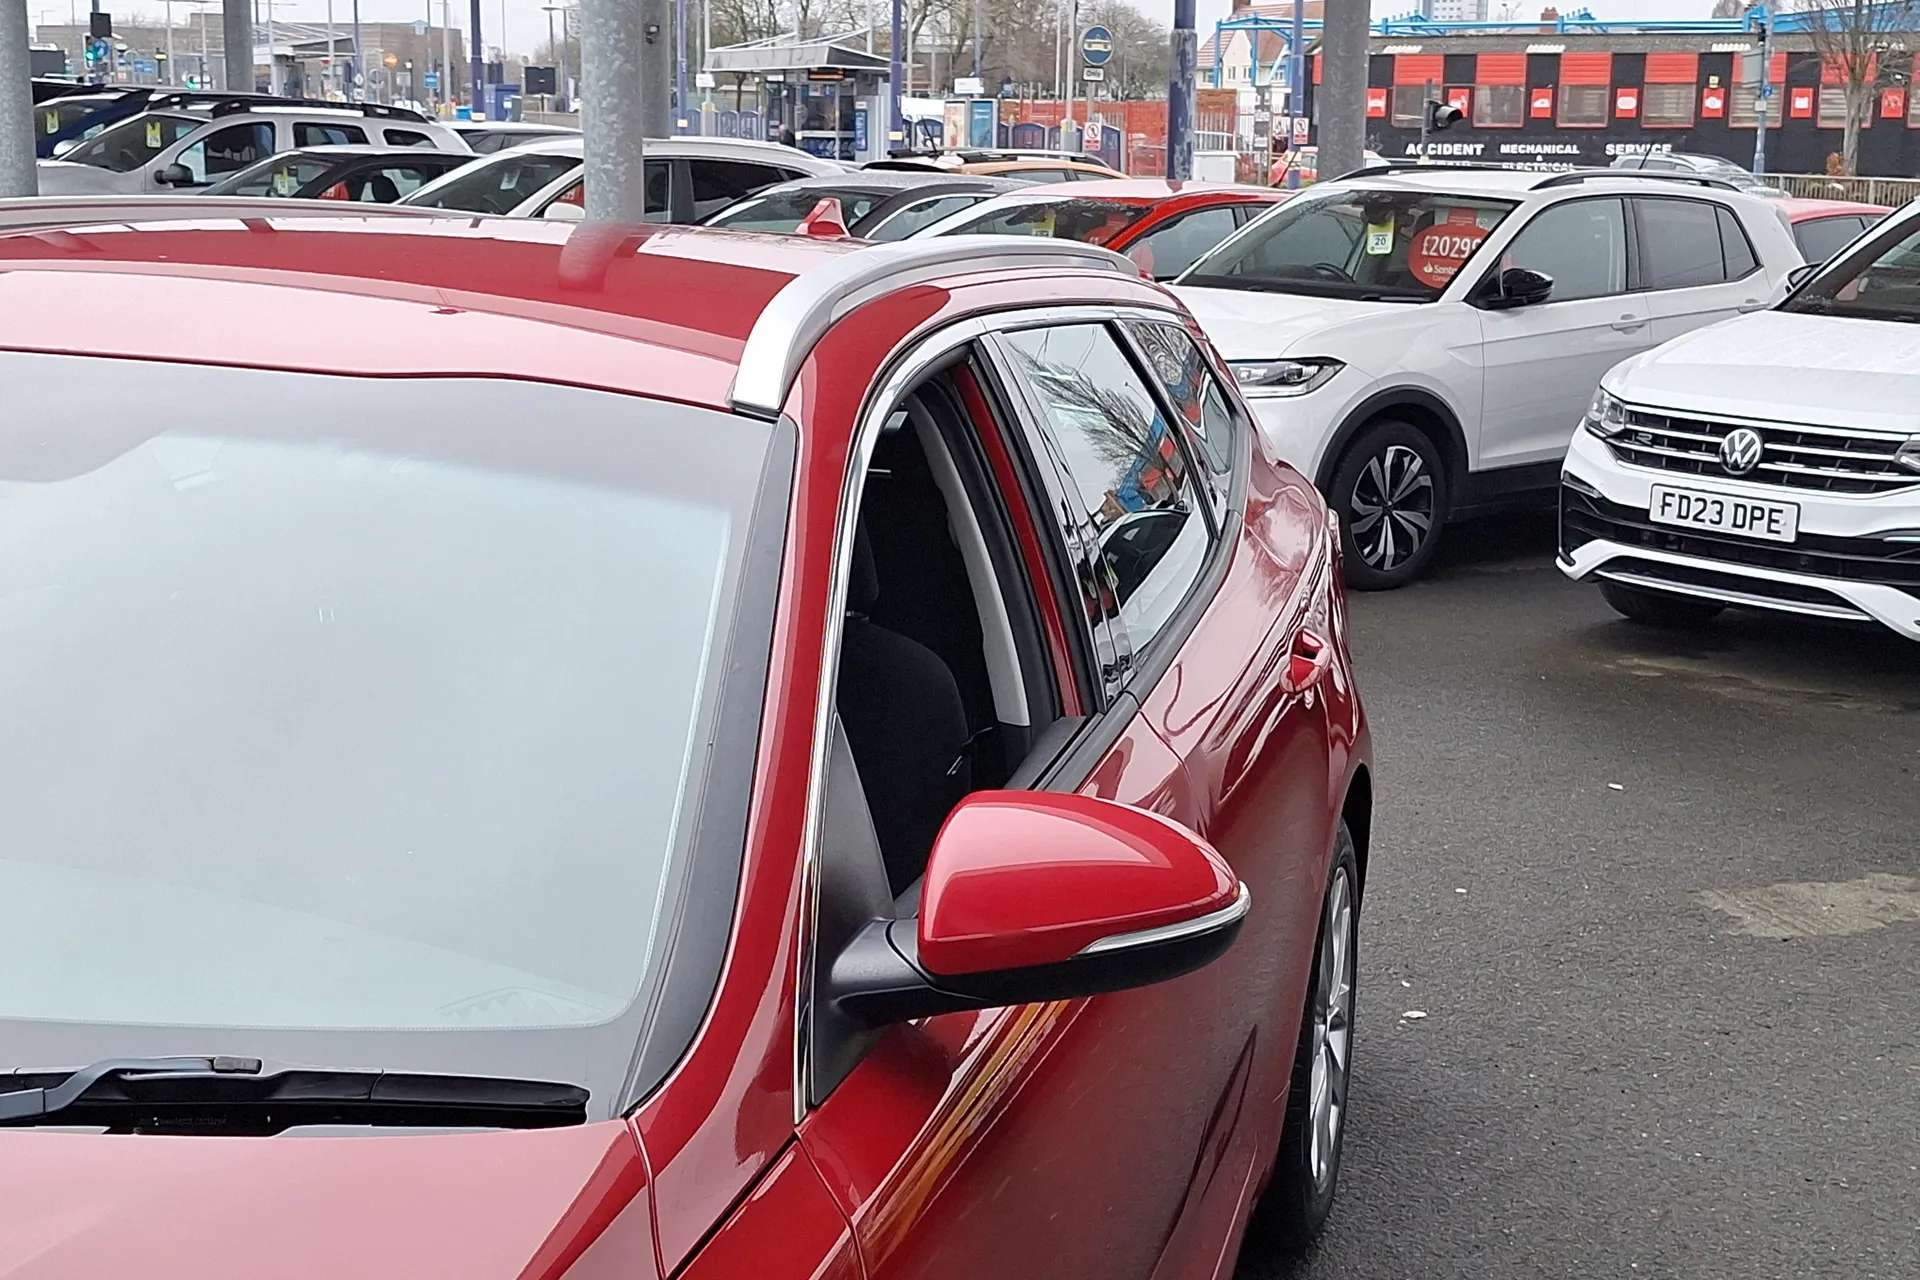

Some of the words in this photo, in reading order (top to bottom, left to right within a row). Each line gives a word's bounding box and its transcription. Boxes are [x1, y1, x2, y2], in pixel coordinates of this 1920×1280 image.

[1405, 143, 1485, 156] ACCIDENT
[1500, 143, 1581, 155] MECHANICAL
[1604, 143, 1673, 156] SERVICE
[1374, 237, 1387, 246] 20
[1660, 491, 1725, 526] FD23
[1731, 502, 1784, 535] DPE
